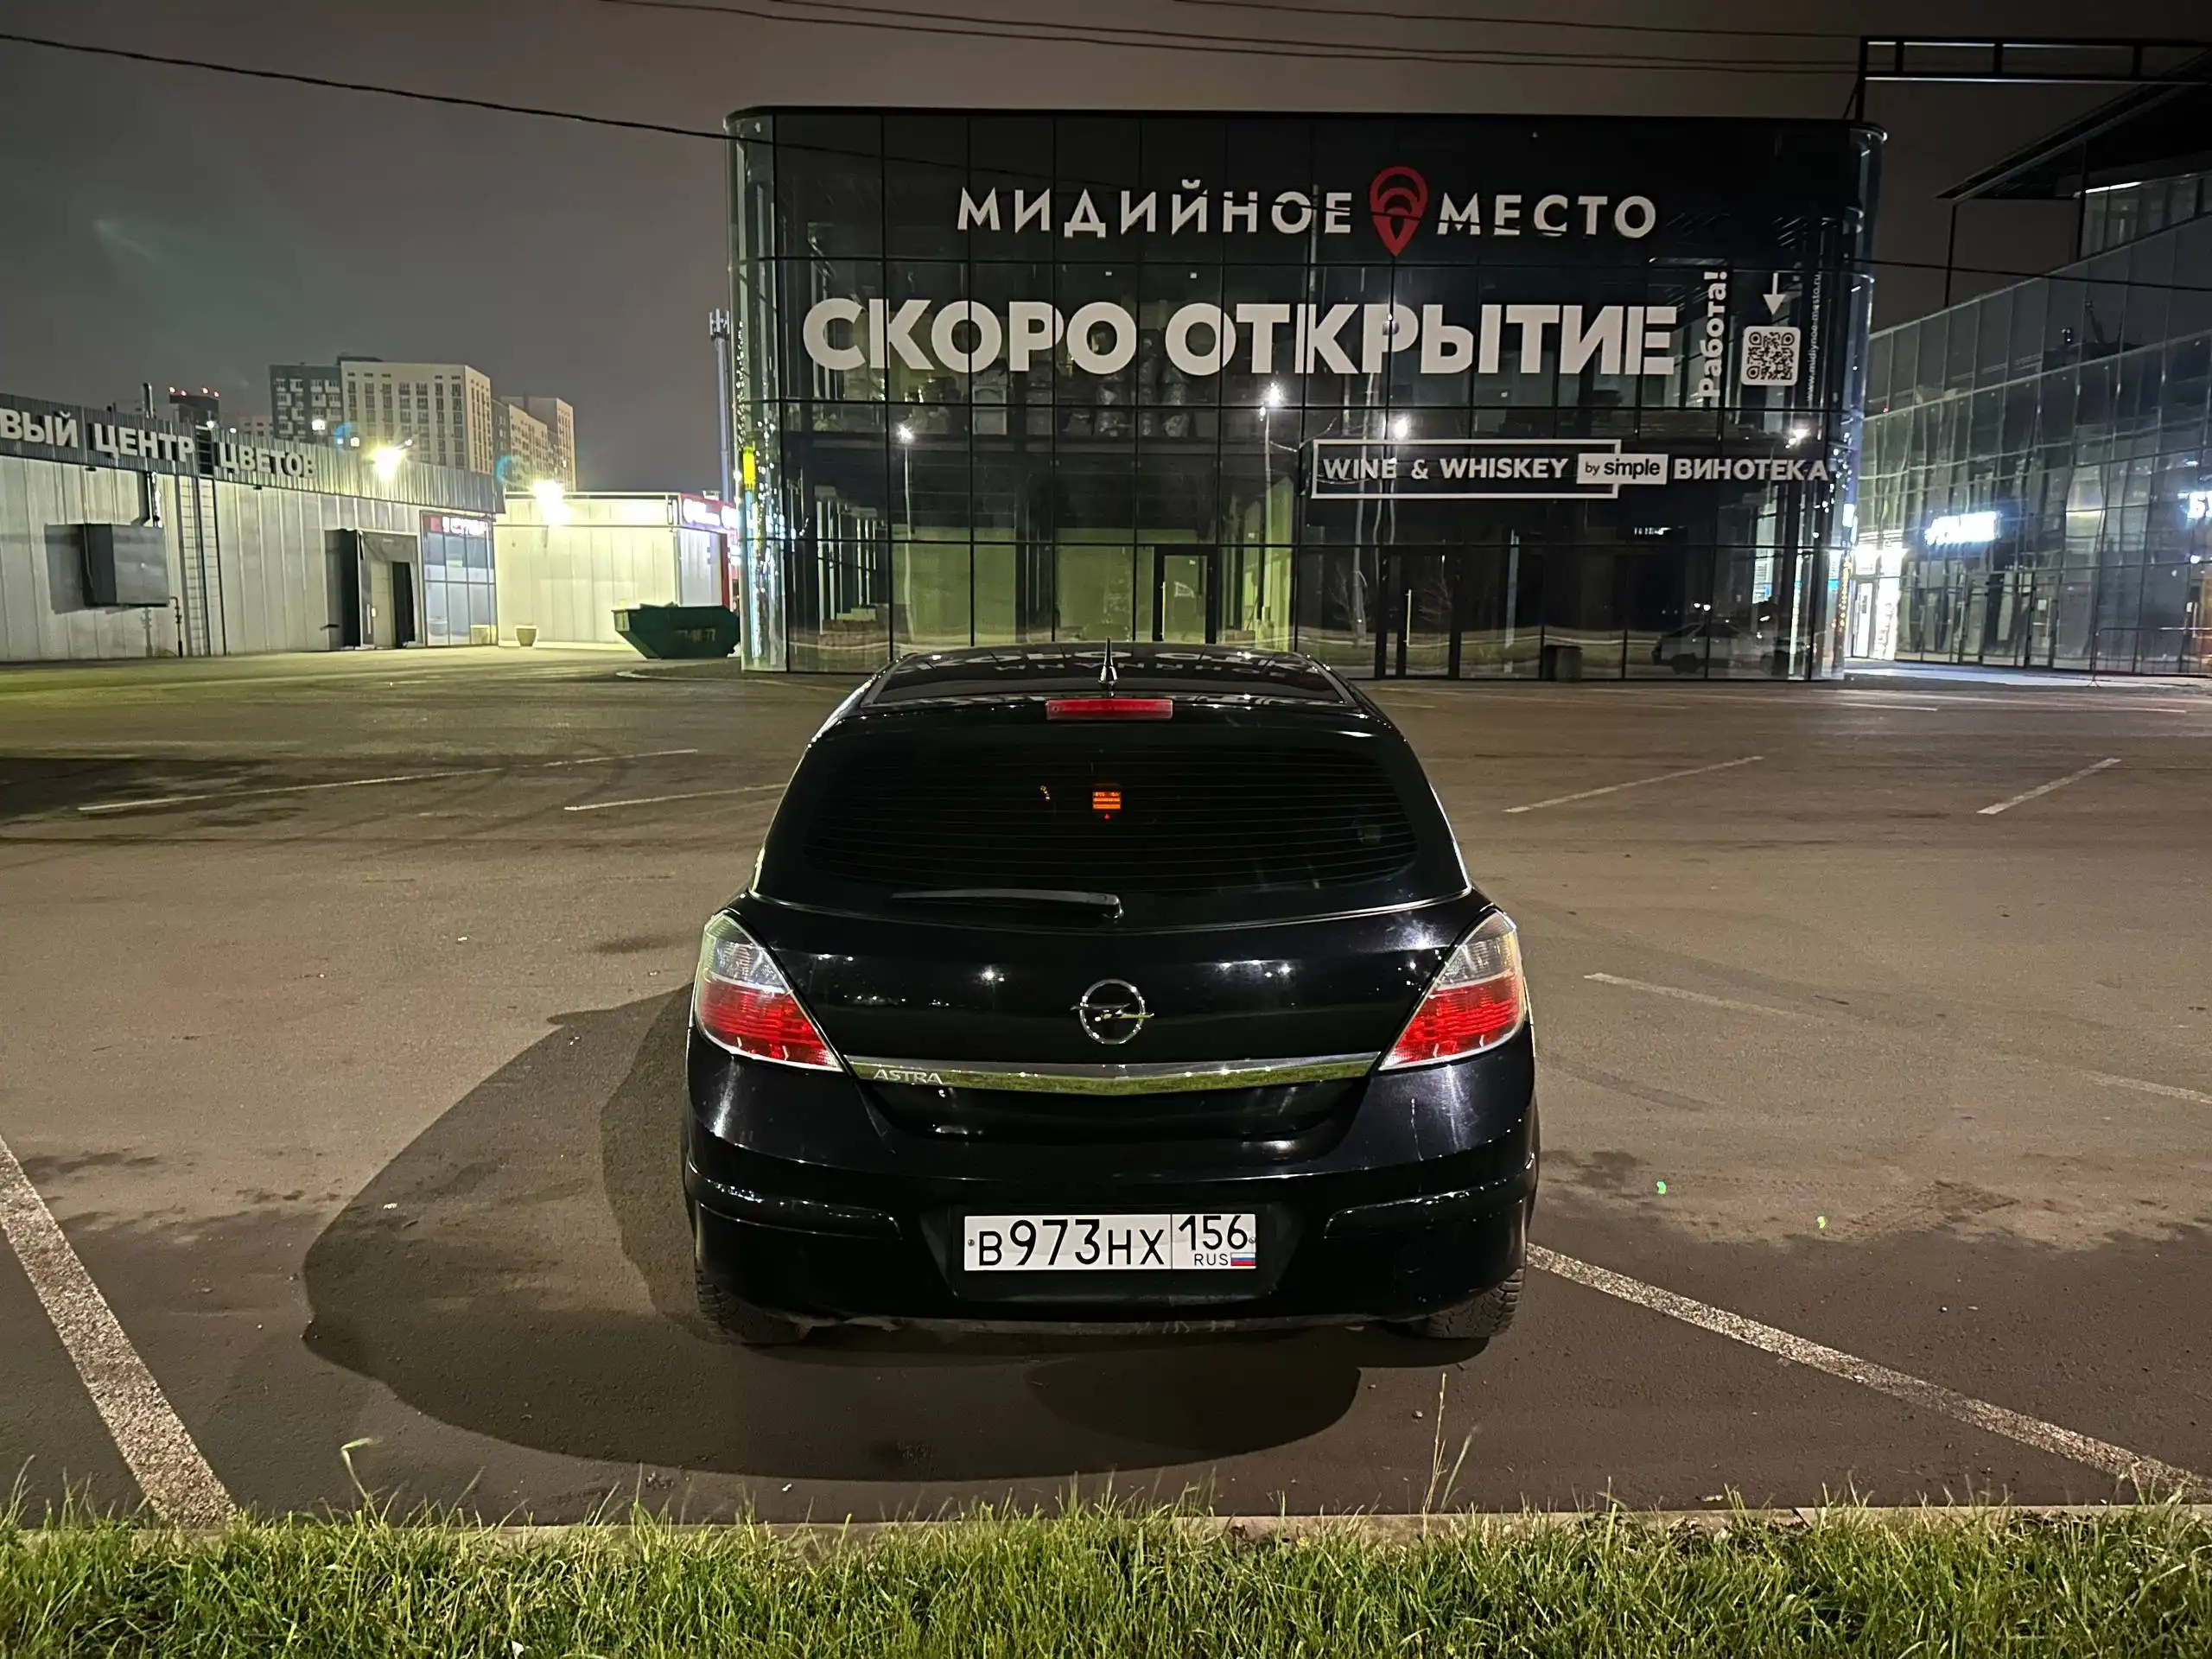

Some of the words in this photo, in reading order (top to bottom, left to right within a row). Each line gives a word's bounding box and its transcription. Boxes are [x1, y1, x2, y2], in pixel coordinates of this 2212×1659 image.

[957, 178, 1353, 239] МИДИЙНОЕ
[1436, 193, 1657, 239] МЕСТО
[802, 297, 1138, 376] СКОРО
[1165, 302, 1677, 377] ОТКРЫТИЕ
[1698, 271, 1727, 398] Работа!
[0, 408, 79, 448] ВЫЙ
[94, 423, 196, 462] ЦЕНТР
[219, 442, 317, 478] ЦВЕТОВ
[1323, 457, 1397, 480] WINE
[1411, 459, 1429, 480] &
[1440, 457, 1569, 480] WHISKEY
[1585, 461, 1600, 475] by
[1604, 458, 1661, 480] simple
[1673, 458, 1830, 481] ВИНОТЕКА
[873, 1068, 944, 1086] ASTRA
[1178, 1214, 1249, 1252] 156
[1193, 1252, 1229, 1267] RUS
